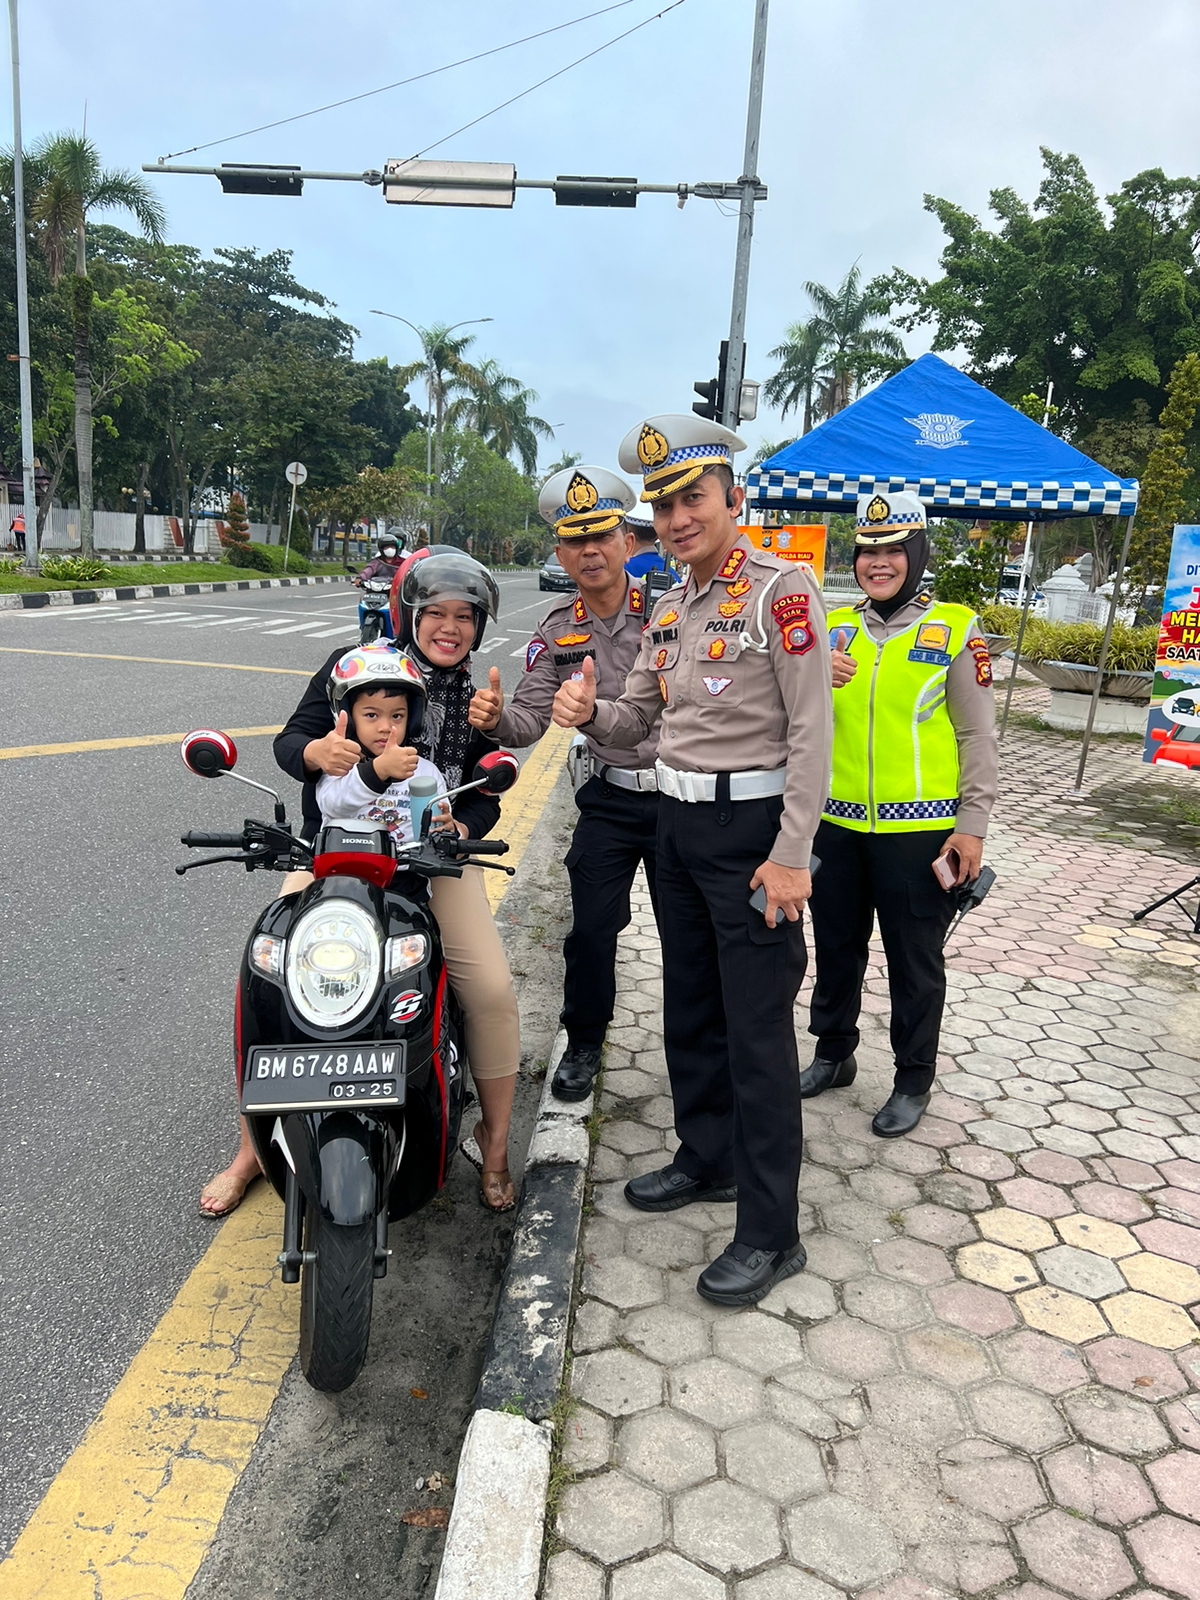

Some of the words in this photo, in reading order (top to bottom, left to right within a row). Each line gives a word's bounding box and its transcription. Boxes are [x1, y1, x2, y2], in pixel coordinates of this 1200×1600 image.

[773, 596, 806, 611] POLDA
[782, 609, 801, 619] RIAU
[704, 619, 746, 633] POLRI
[256, 1056, 287, 1079] BM
[292, 1054, 349, 1077] 6748
[353, 1052, 396, 1075] AAW
